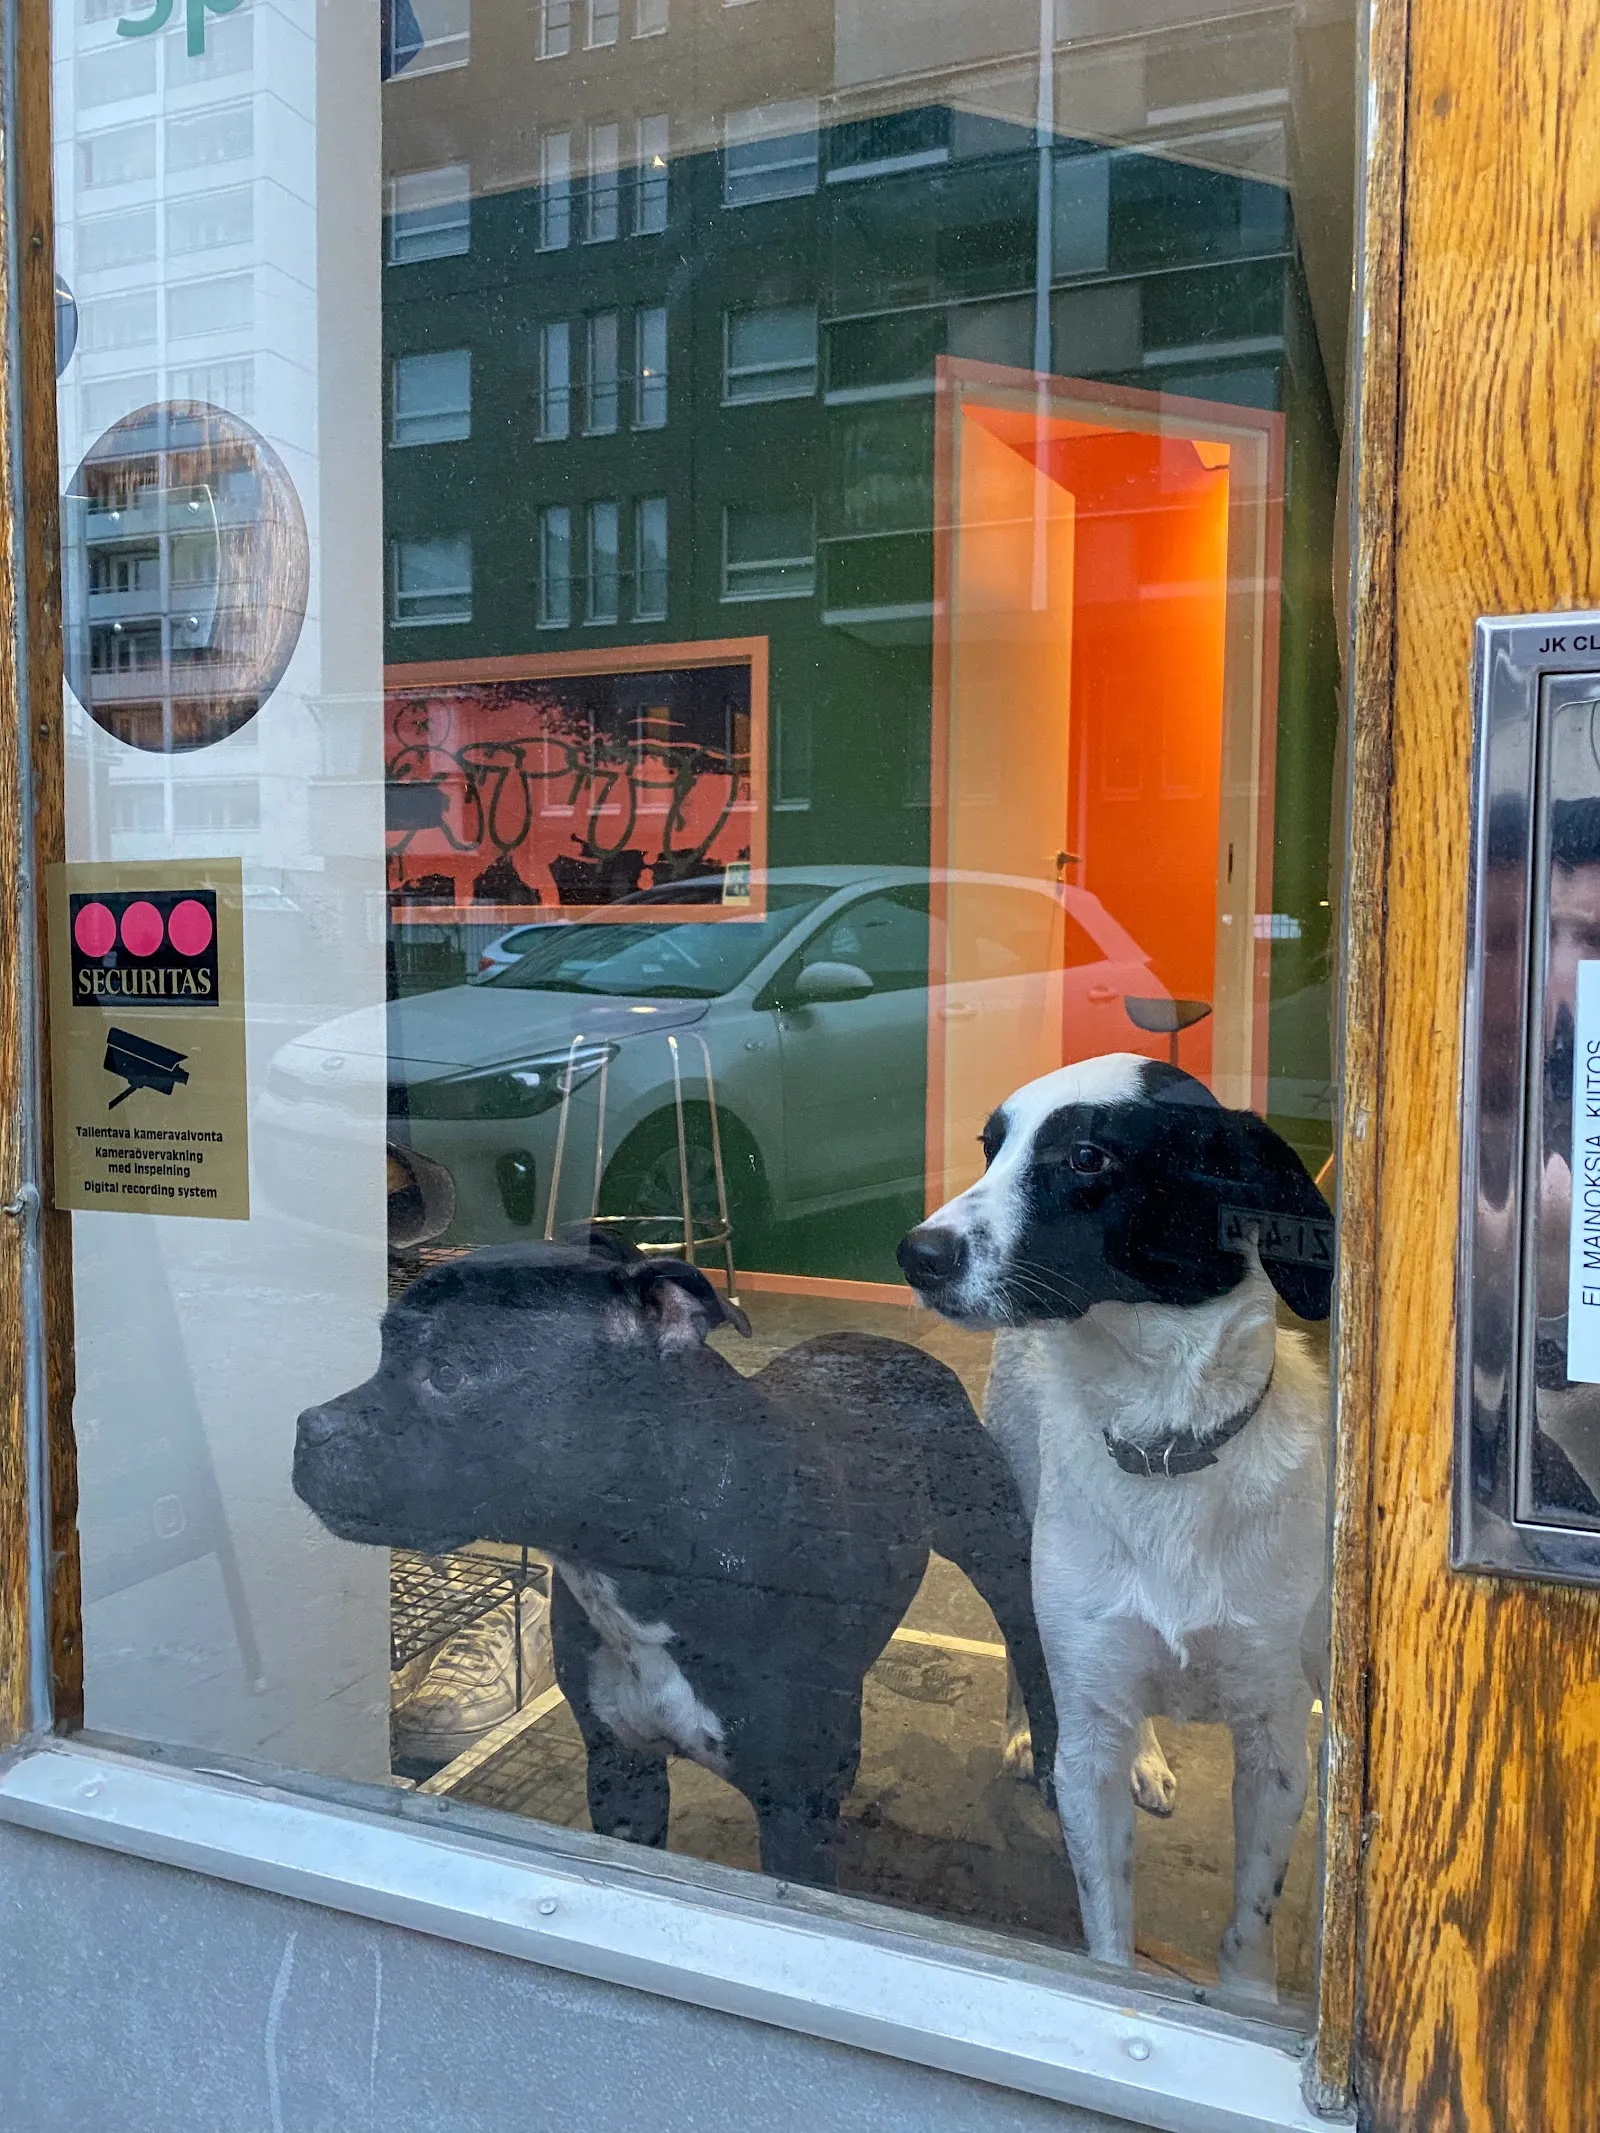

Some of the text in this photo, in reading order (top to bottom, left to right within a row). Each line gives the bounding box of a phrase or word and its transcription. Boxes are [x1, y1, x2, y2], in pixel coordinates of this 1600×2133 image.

[1538, 636, 1566, 653] JK
[78, 967, 212, 996] SECURITAS
[75, 1126, 223, 1142] Tallentava kameravalvonta
[95, 1146, 204, 1163] Kameraövervakning
[108, 1162, 191, 1178] med inspelning
[84, 1180, 217, 1199] Digital recording system
[1583, 1135, 1600, 1270] MAINOKSIA
